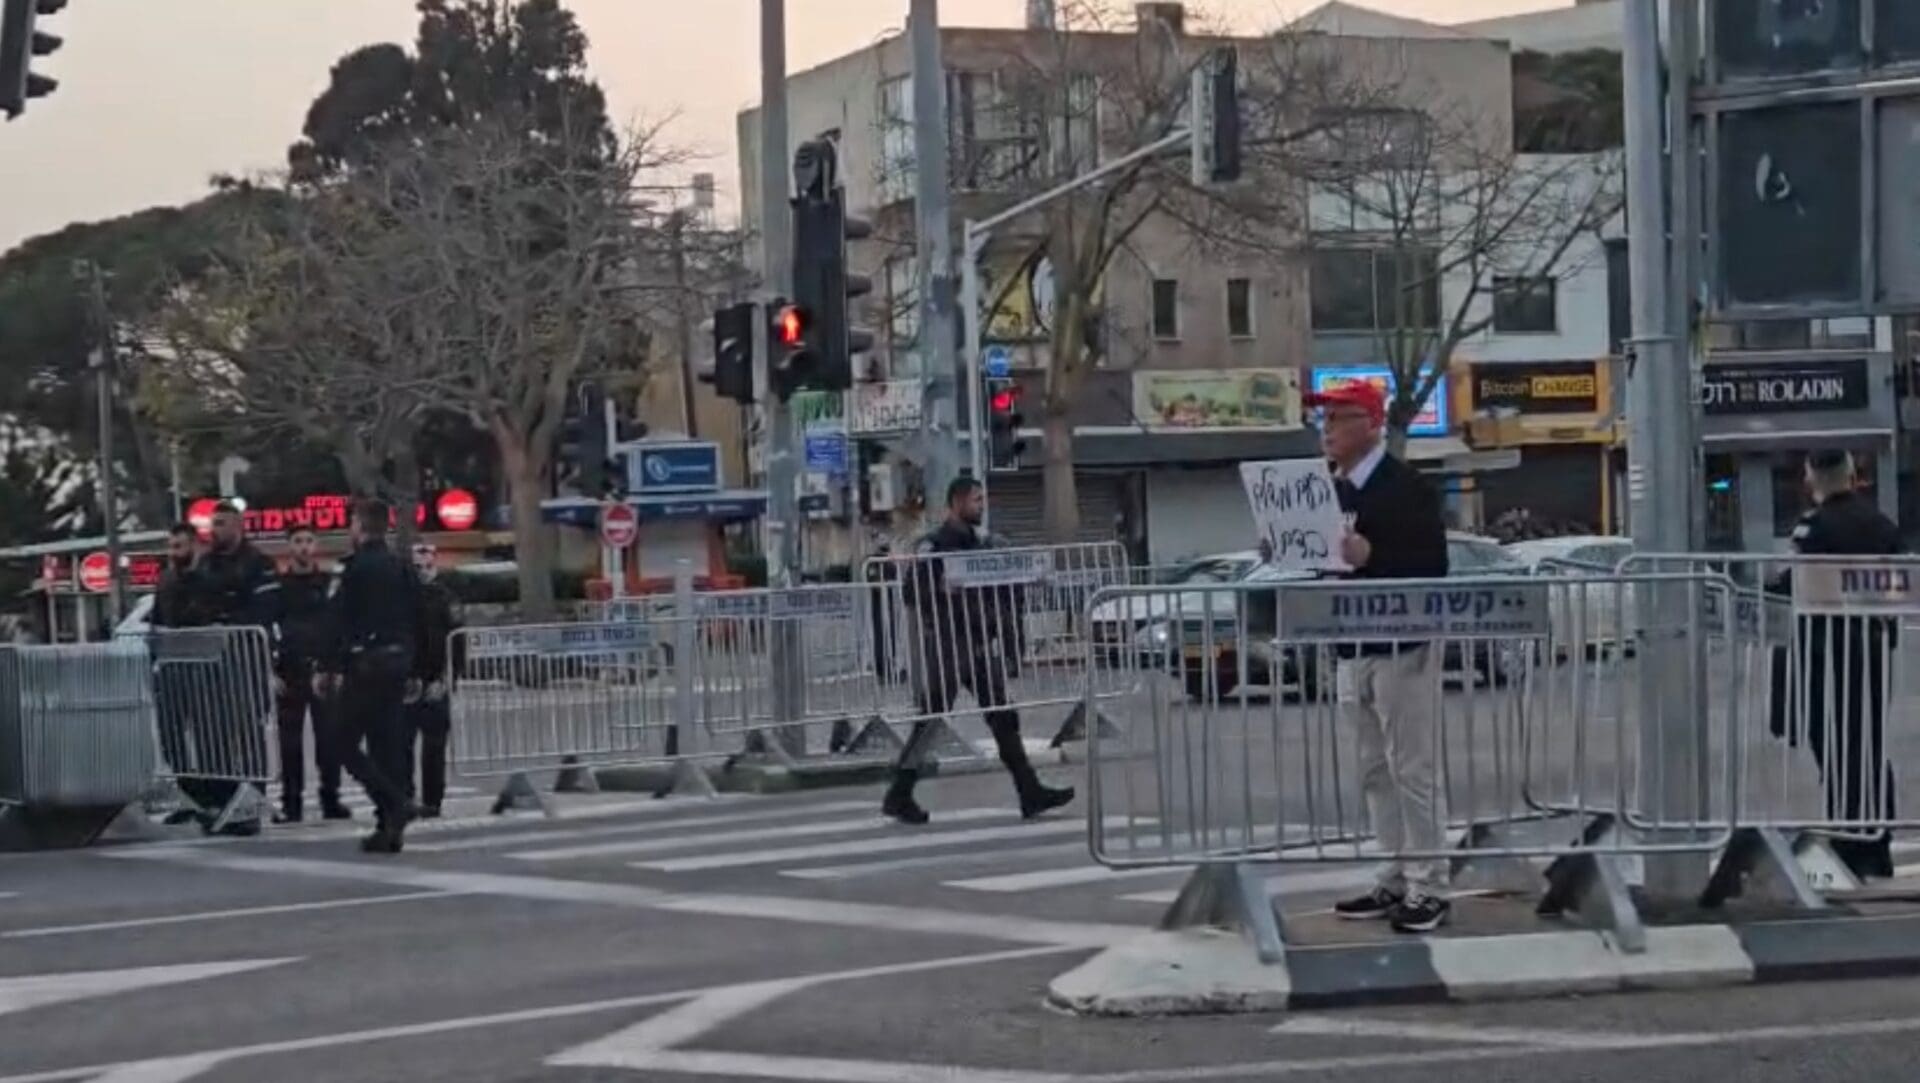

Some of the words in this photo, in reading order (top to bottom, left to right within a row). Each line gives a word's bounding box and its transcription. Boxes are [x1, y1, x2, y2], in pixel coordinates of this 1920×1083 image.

[1480, 380, 1528, 397] Bitcoin
[1534, 378, 1593, 393] CHANGE
[1757, 378, 1844, 402] ROLADIN
[1841, 568, 1910, 593] במות
[1331, 593, 1409, 617] במות
[1424, 591, 1494, 618] קשת
